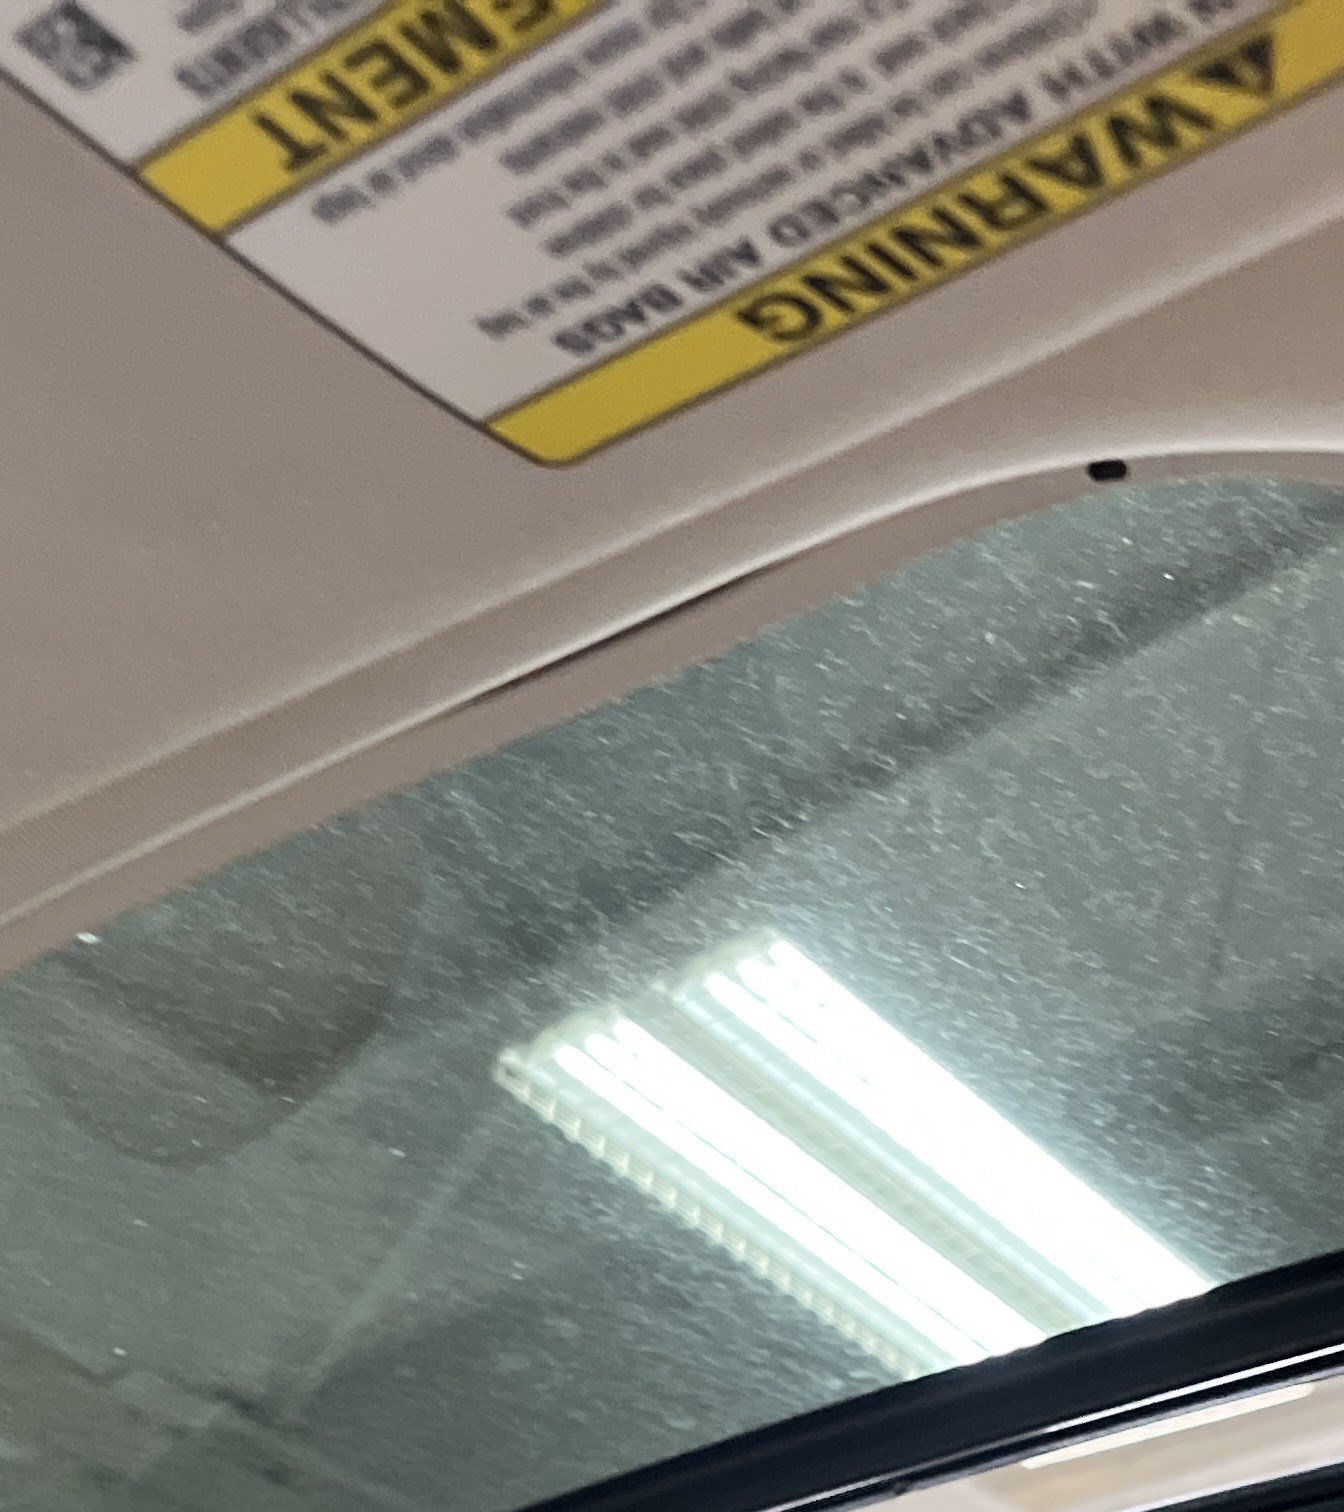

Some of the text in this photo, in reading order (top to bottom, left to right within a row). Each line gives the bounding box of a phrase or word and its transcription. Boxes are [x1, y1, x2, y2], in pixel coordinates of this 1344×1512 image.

[1041, 16, 1182, 104] WITH
[768, 94, 1034, 248] ADVANCED
[736, 90, 1218, 346] WARNING
[675, 236, 763, 296] AIR
[550, 283, 684, 357] BAGS
